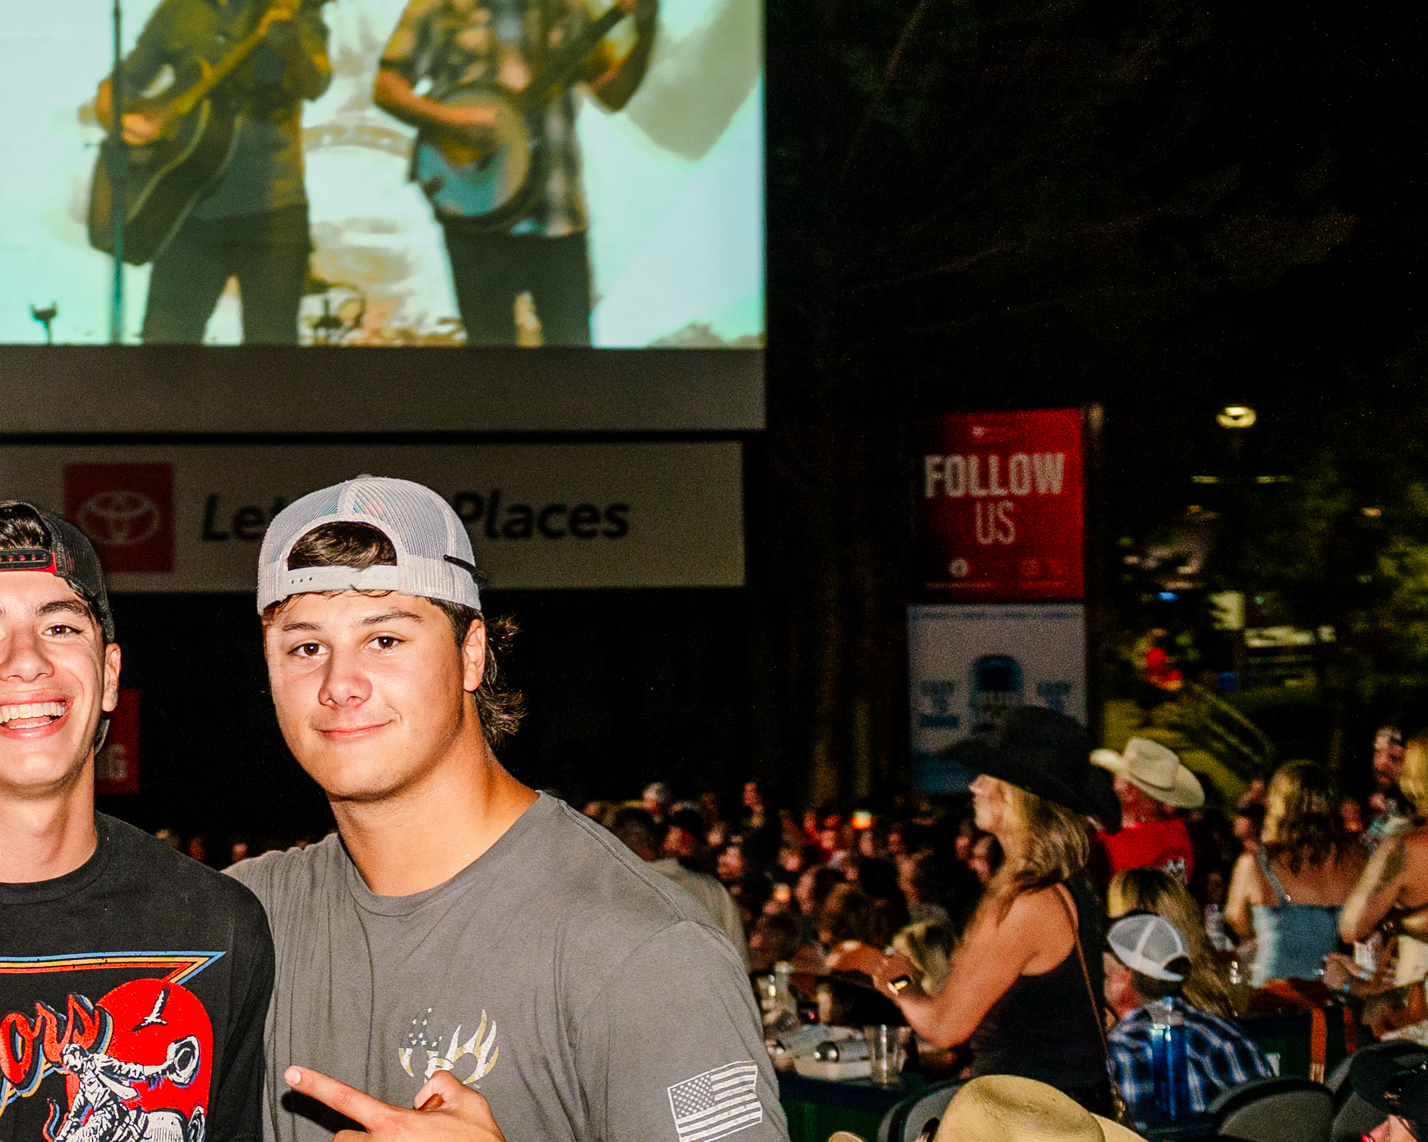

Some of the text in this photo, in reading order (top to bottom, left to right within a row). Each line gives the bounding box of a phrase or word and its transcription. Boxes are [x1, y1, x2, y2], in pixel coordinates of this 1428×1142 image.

[924, 453, 1065, 498] FOLLOW
[453, 489, 630, 539] Places
[975, 500, 1016, 545] US
